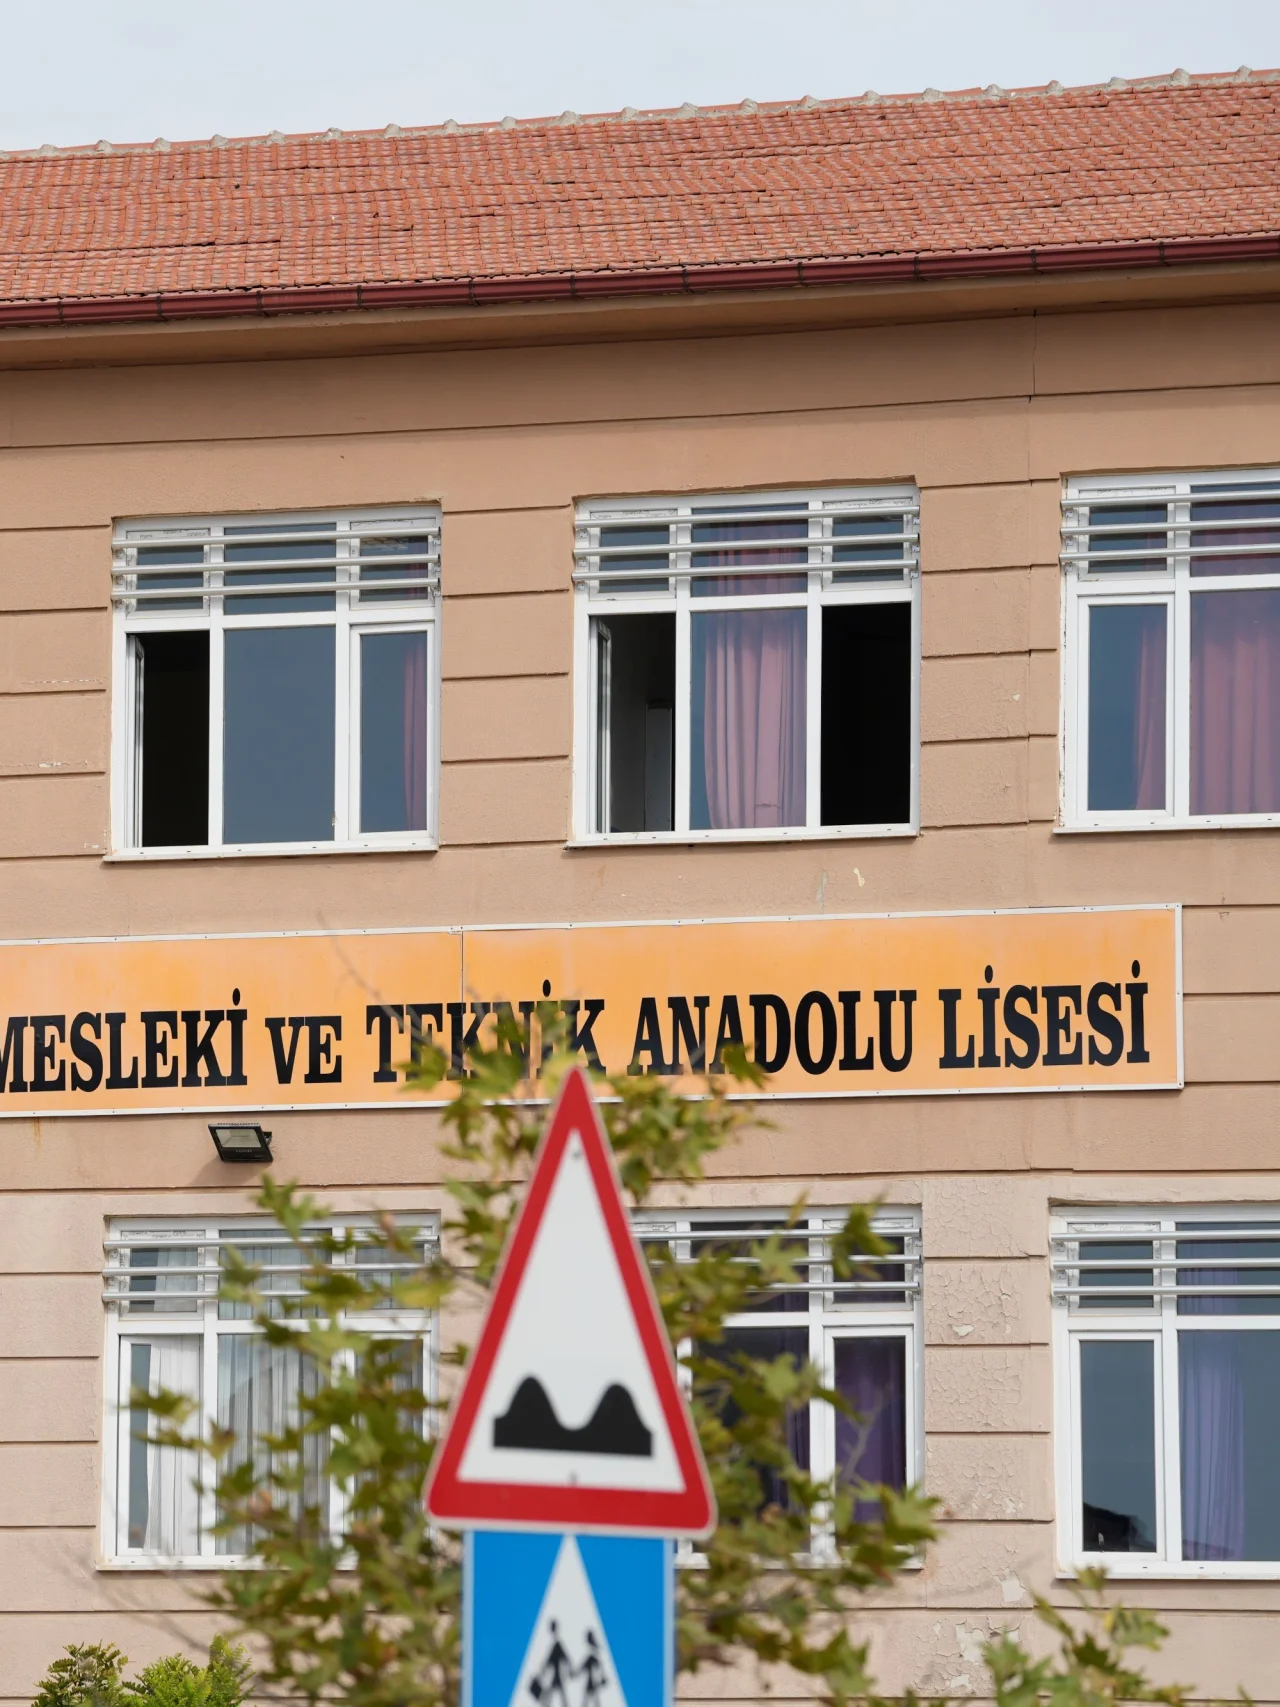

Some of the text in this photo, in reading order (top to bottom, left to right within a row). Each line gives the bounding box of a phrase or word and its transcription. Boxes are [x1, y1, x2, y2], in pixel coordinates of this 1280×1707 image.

[264, 1015, 342, 1085] VE
[626, 990, 917, 1076] ANADOLU
[938, 959, 1150, 1069] LİSESİ
